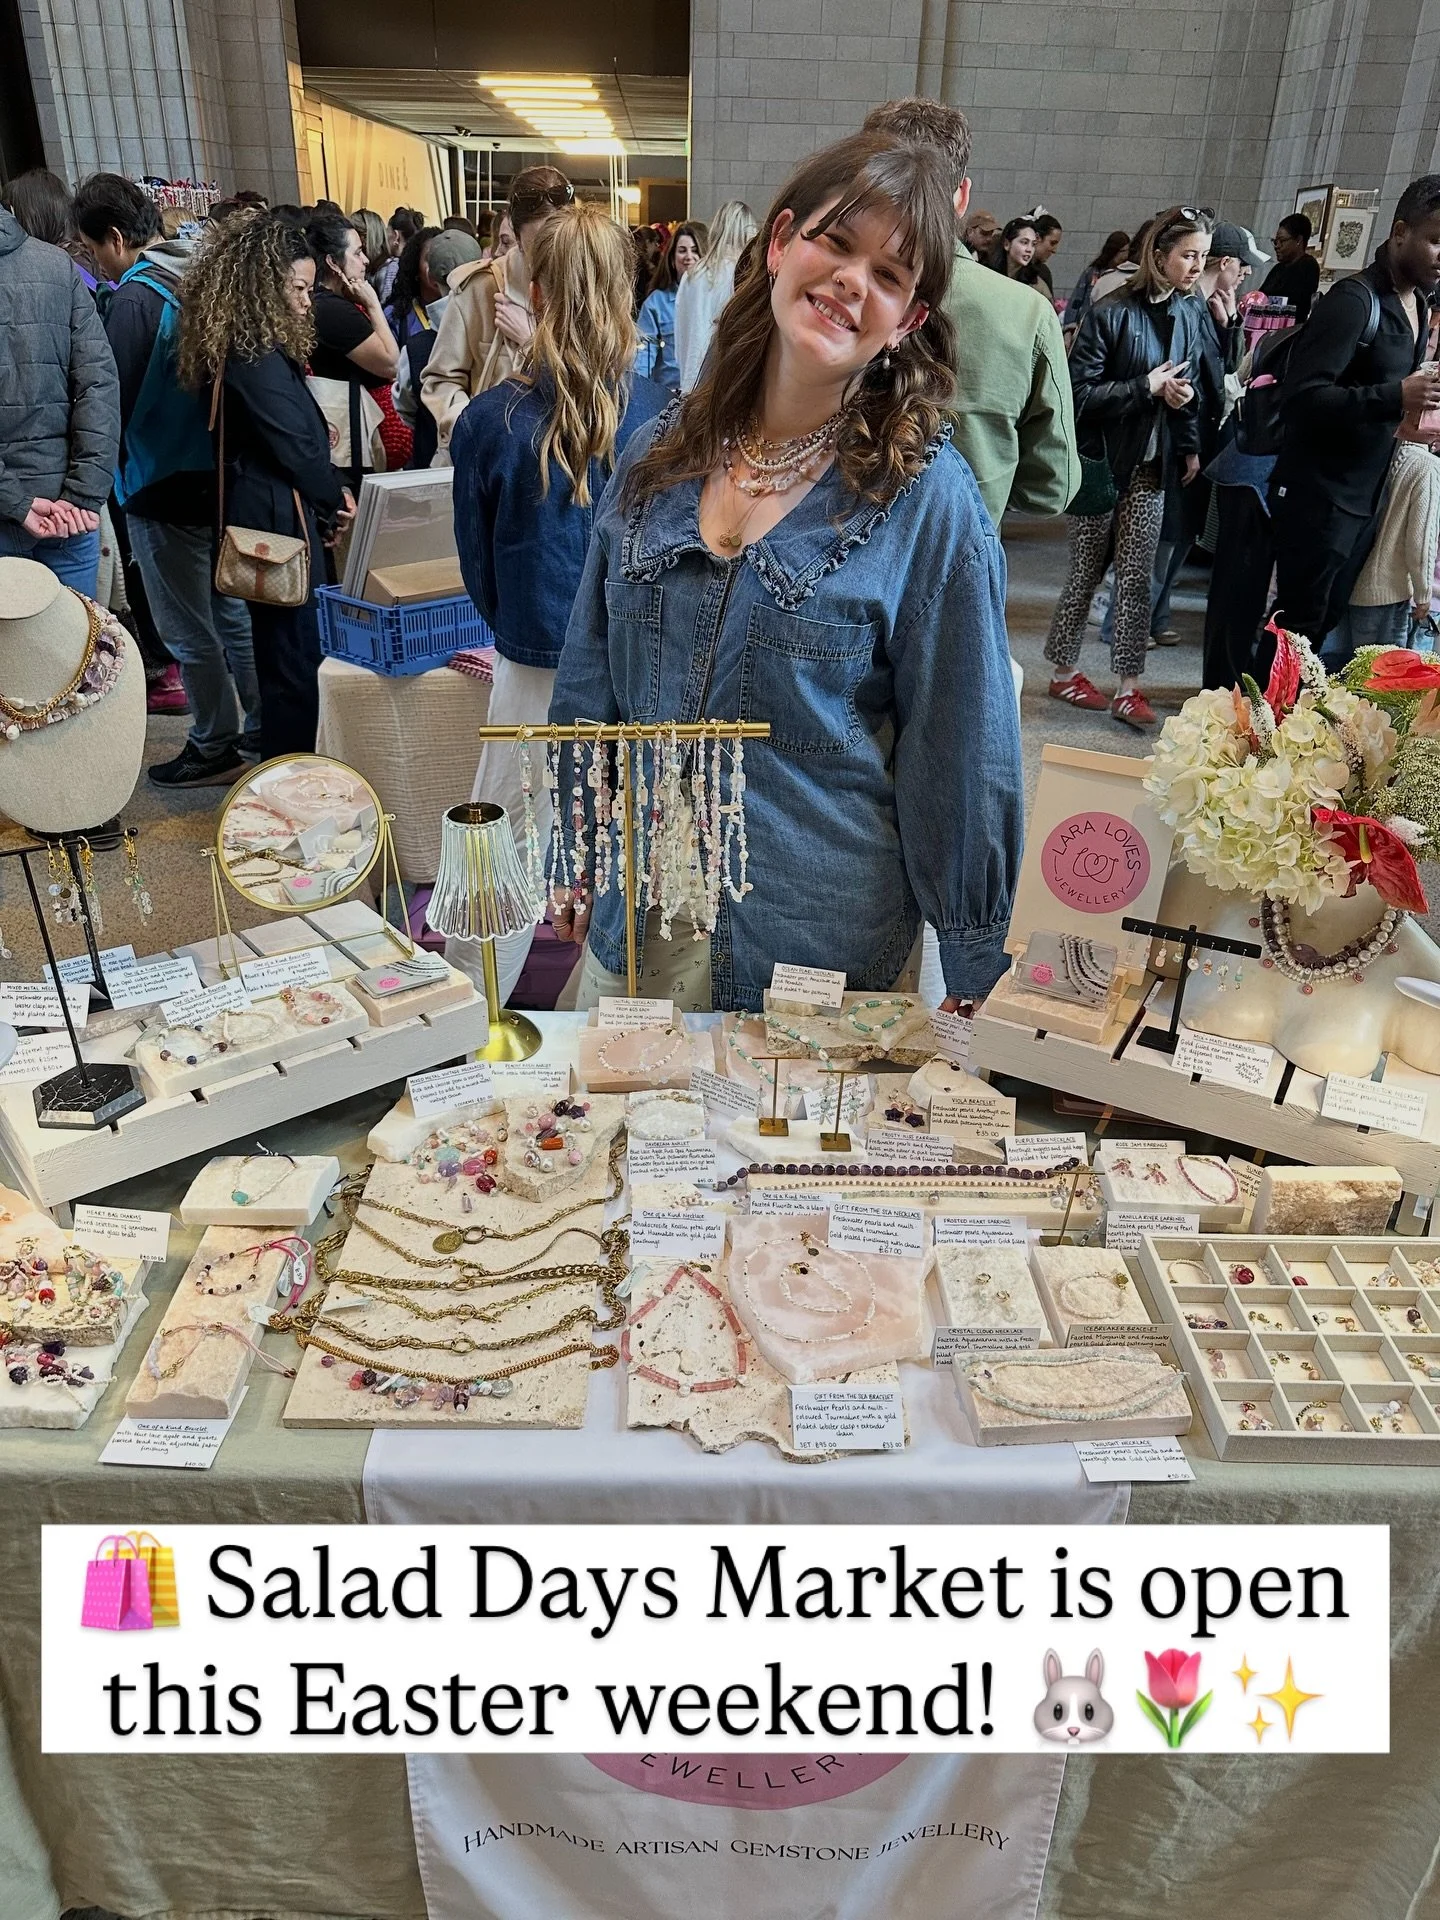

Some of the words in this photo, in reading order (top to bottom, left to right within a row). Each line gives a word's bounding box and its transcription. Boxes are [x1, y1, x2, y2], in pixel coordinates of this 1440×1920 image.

[1052, 820, 1095, 855] LARA
[1105, 822, 1141, 870] LOVES
[1055, 876, 1126, 904] JEWELLERY
[865, 1218, 881, 1227] pearls
[884, 1413, 896, 1422] gold
[796, 1423, 817, 1431] plated
[463, 1821, 604, 1854] HANDMADE
[615, 1838, 719, 1855] ARTISAN
[730, 1839, 869, 1860] GEMSTONE
[876, 1823, 1011, 1858] JEWELLERY
